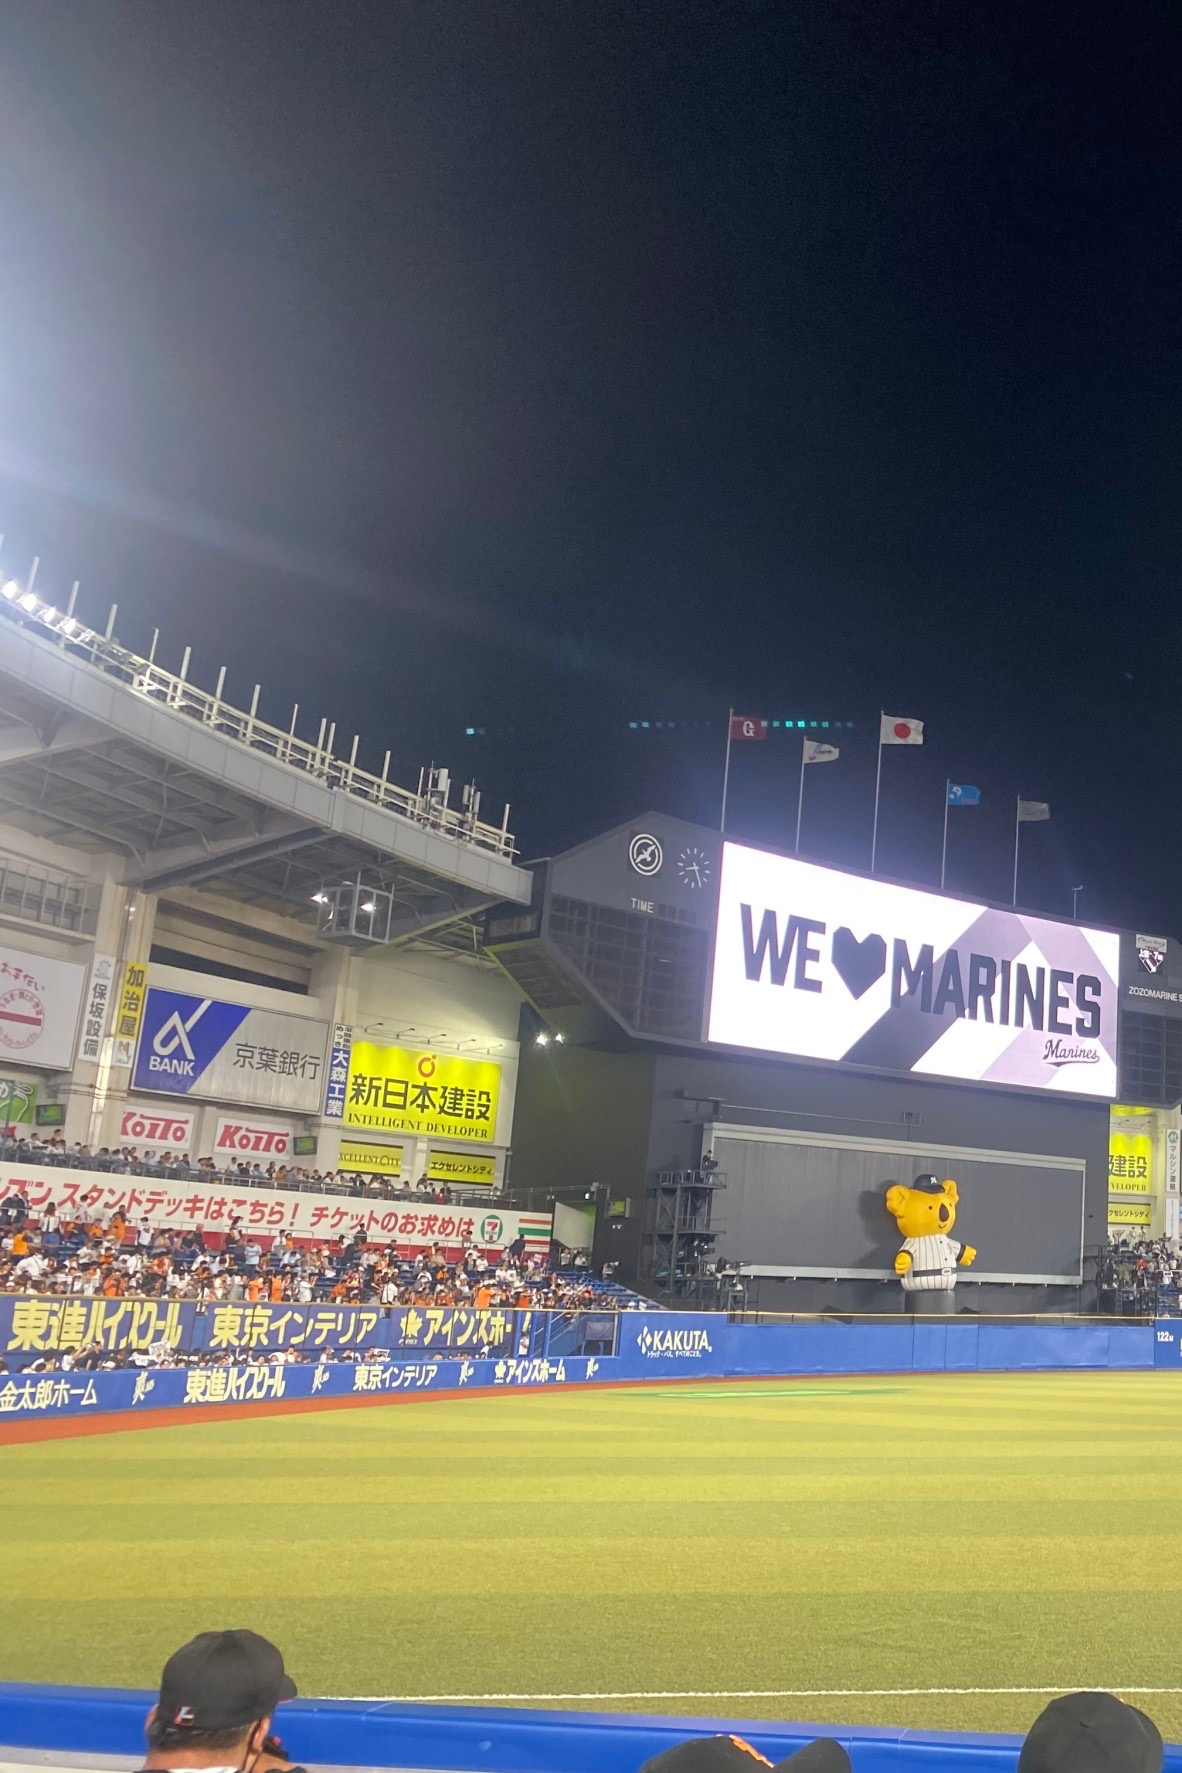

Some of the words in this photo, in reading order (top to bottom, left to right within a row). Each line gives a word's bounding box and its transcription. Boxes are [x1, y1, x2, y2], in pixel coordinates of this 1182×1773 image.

[631, 897, 655, 913] TIME
[739, 902, 827, 995] WE
[891, 937, 1102, 1040] MARINES
[118, 965, 144, 1037] 加治屋
[1129, 986, 1178, 1001] ZOZOMARINE
[83, 982, 108, 1057] 保坂設備
[149, 1055, 195, 1077] BANK
[233, 1042, 321, 1080] 京葉銀行
[1041, 1037, 1101, 1068] Marines
[326, 1050, 349, 1116] 大森工業
[349, 1072, 492, 1121] 新日本建設
[348, 1112, 422, 1131] INTELLIGENT
[426, 1122, 488, 1139] DEVELOPER
[338, 1152, 380, 1165] XCELLENT
[430, 1161, 493, 1176] エクセレントシティ
[310, 1205, 475, 1238] チケットのお求めは
[1109, 1209, 1150, 1219] クセレントシティ
[7, 1299, 183, 1351] 東進ハイスクール
[209, 1304, 378, 1348] 東京インテリア
[652, 1330, 709, 1351] KAKUTA
[184, 1366, 286, 1404] 東進ハイスクール
[352, 1363, 438, 1391] 東京インテリア
[505, 1359, 566, 1384] アインズホーム
[0, 1379, 98, 1412] 金太郎ホーム
